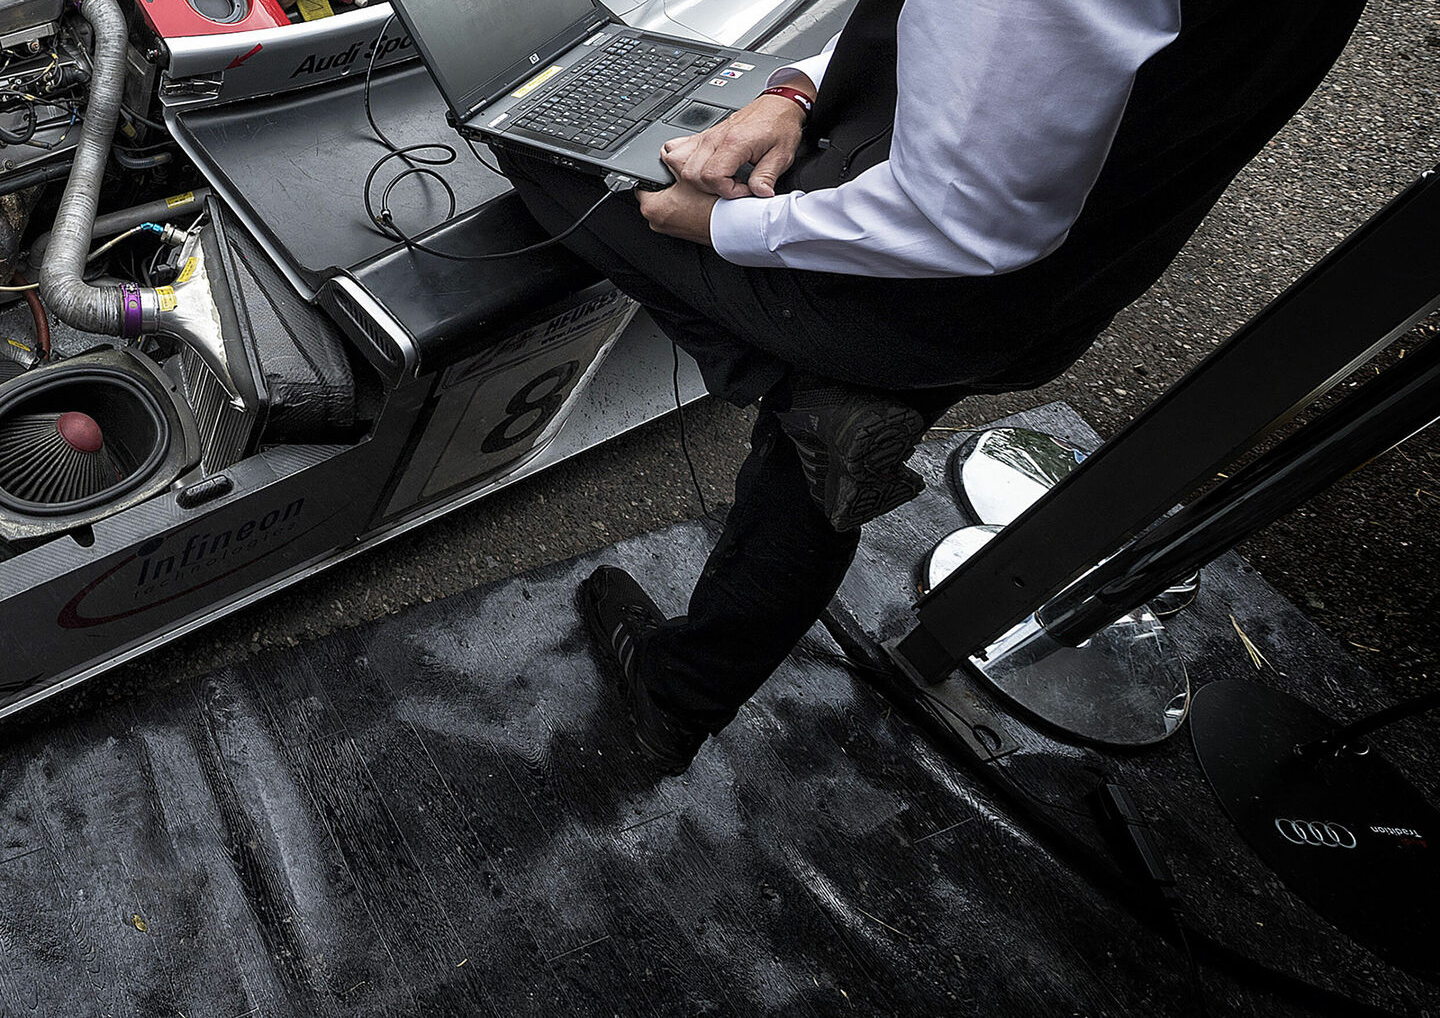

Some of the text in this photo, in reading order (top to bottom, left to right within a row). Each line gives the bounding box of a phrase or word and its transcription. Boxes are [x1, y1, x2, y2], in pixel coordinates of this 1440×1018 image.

[289, 41, 364, 79] Audi
[481, 360, 579, 454] 8
[1370, 826, 1424, 838] Tradition
